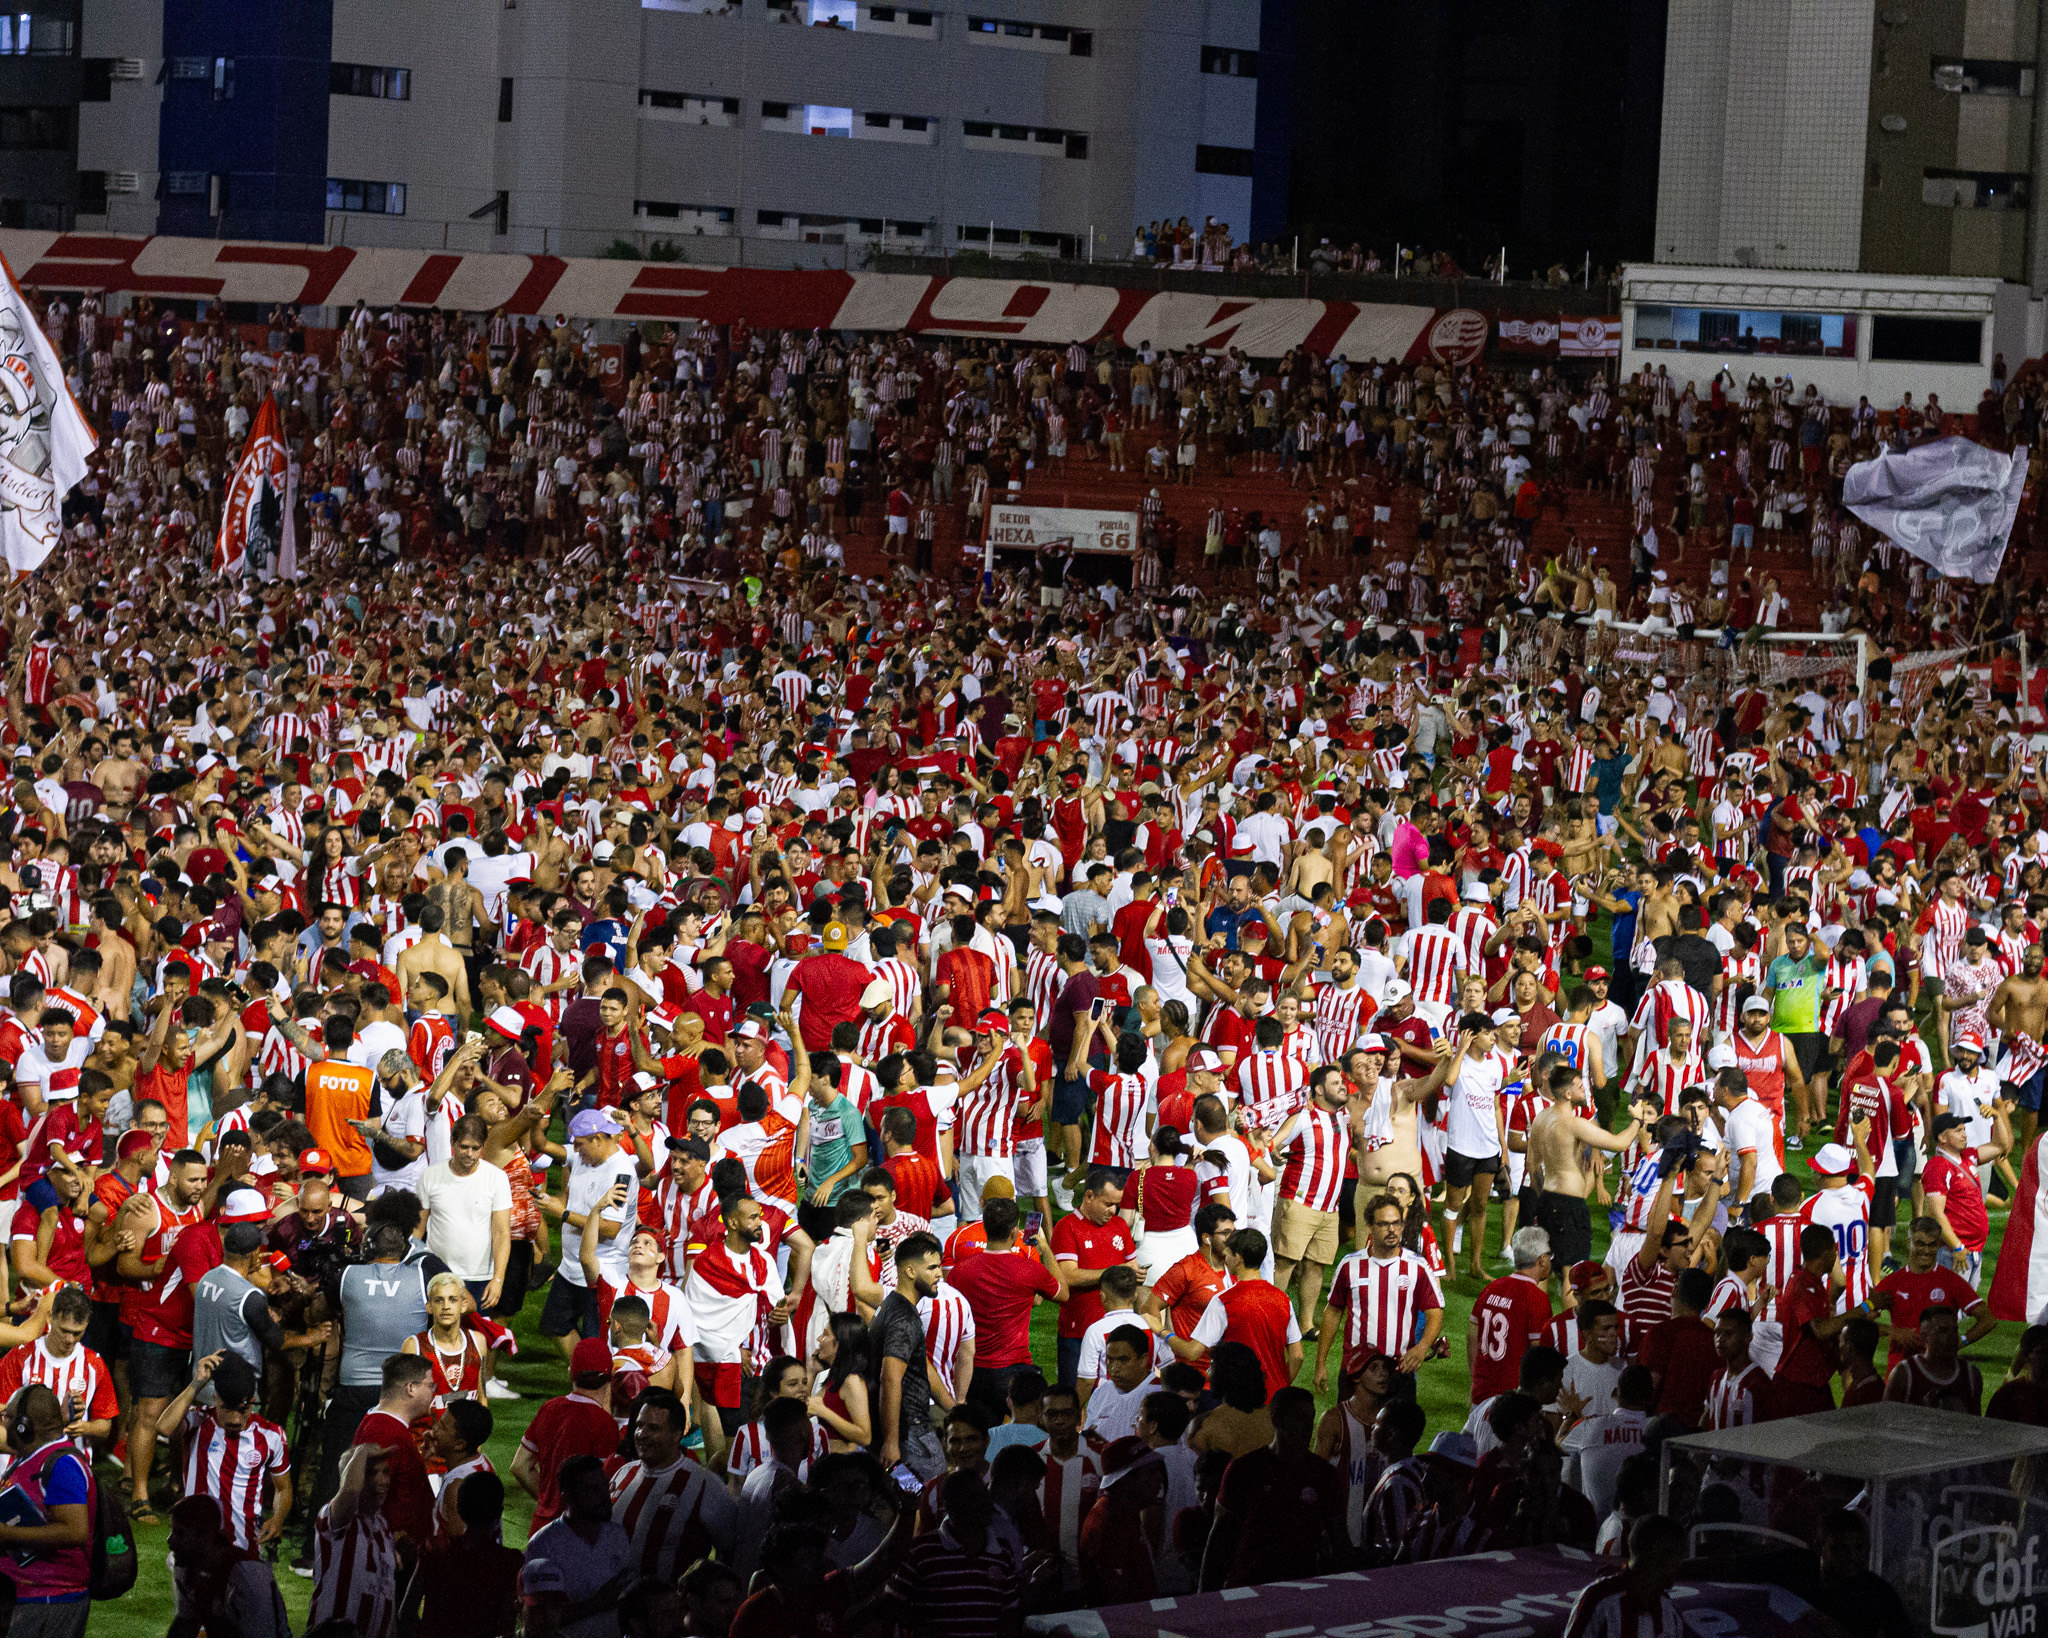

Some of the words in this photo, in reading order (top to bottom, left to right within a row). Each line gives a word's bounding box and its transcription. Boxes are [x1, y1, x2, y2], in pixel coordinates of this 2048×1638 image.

[998, 512, 1031, 525] SETOR
[993, 526, 1035, 543] HEXA
[1100, 532, 1130, 549] 66
[319, 1074, 359, 1092] FOTO
[1832, 1219, 1867, 1261] 10
[202, 1280, 225, 1303] TV
[364, 1279, 400, 1298] TV
[1481, 1308, 1509, 1361] 13
[1974, 1535, 2039, 1605] cbf
[1991, 1604, 2036, 1638] VAR
